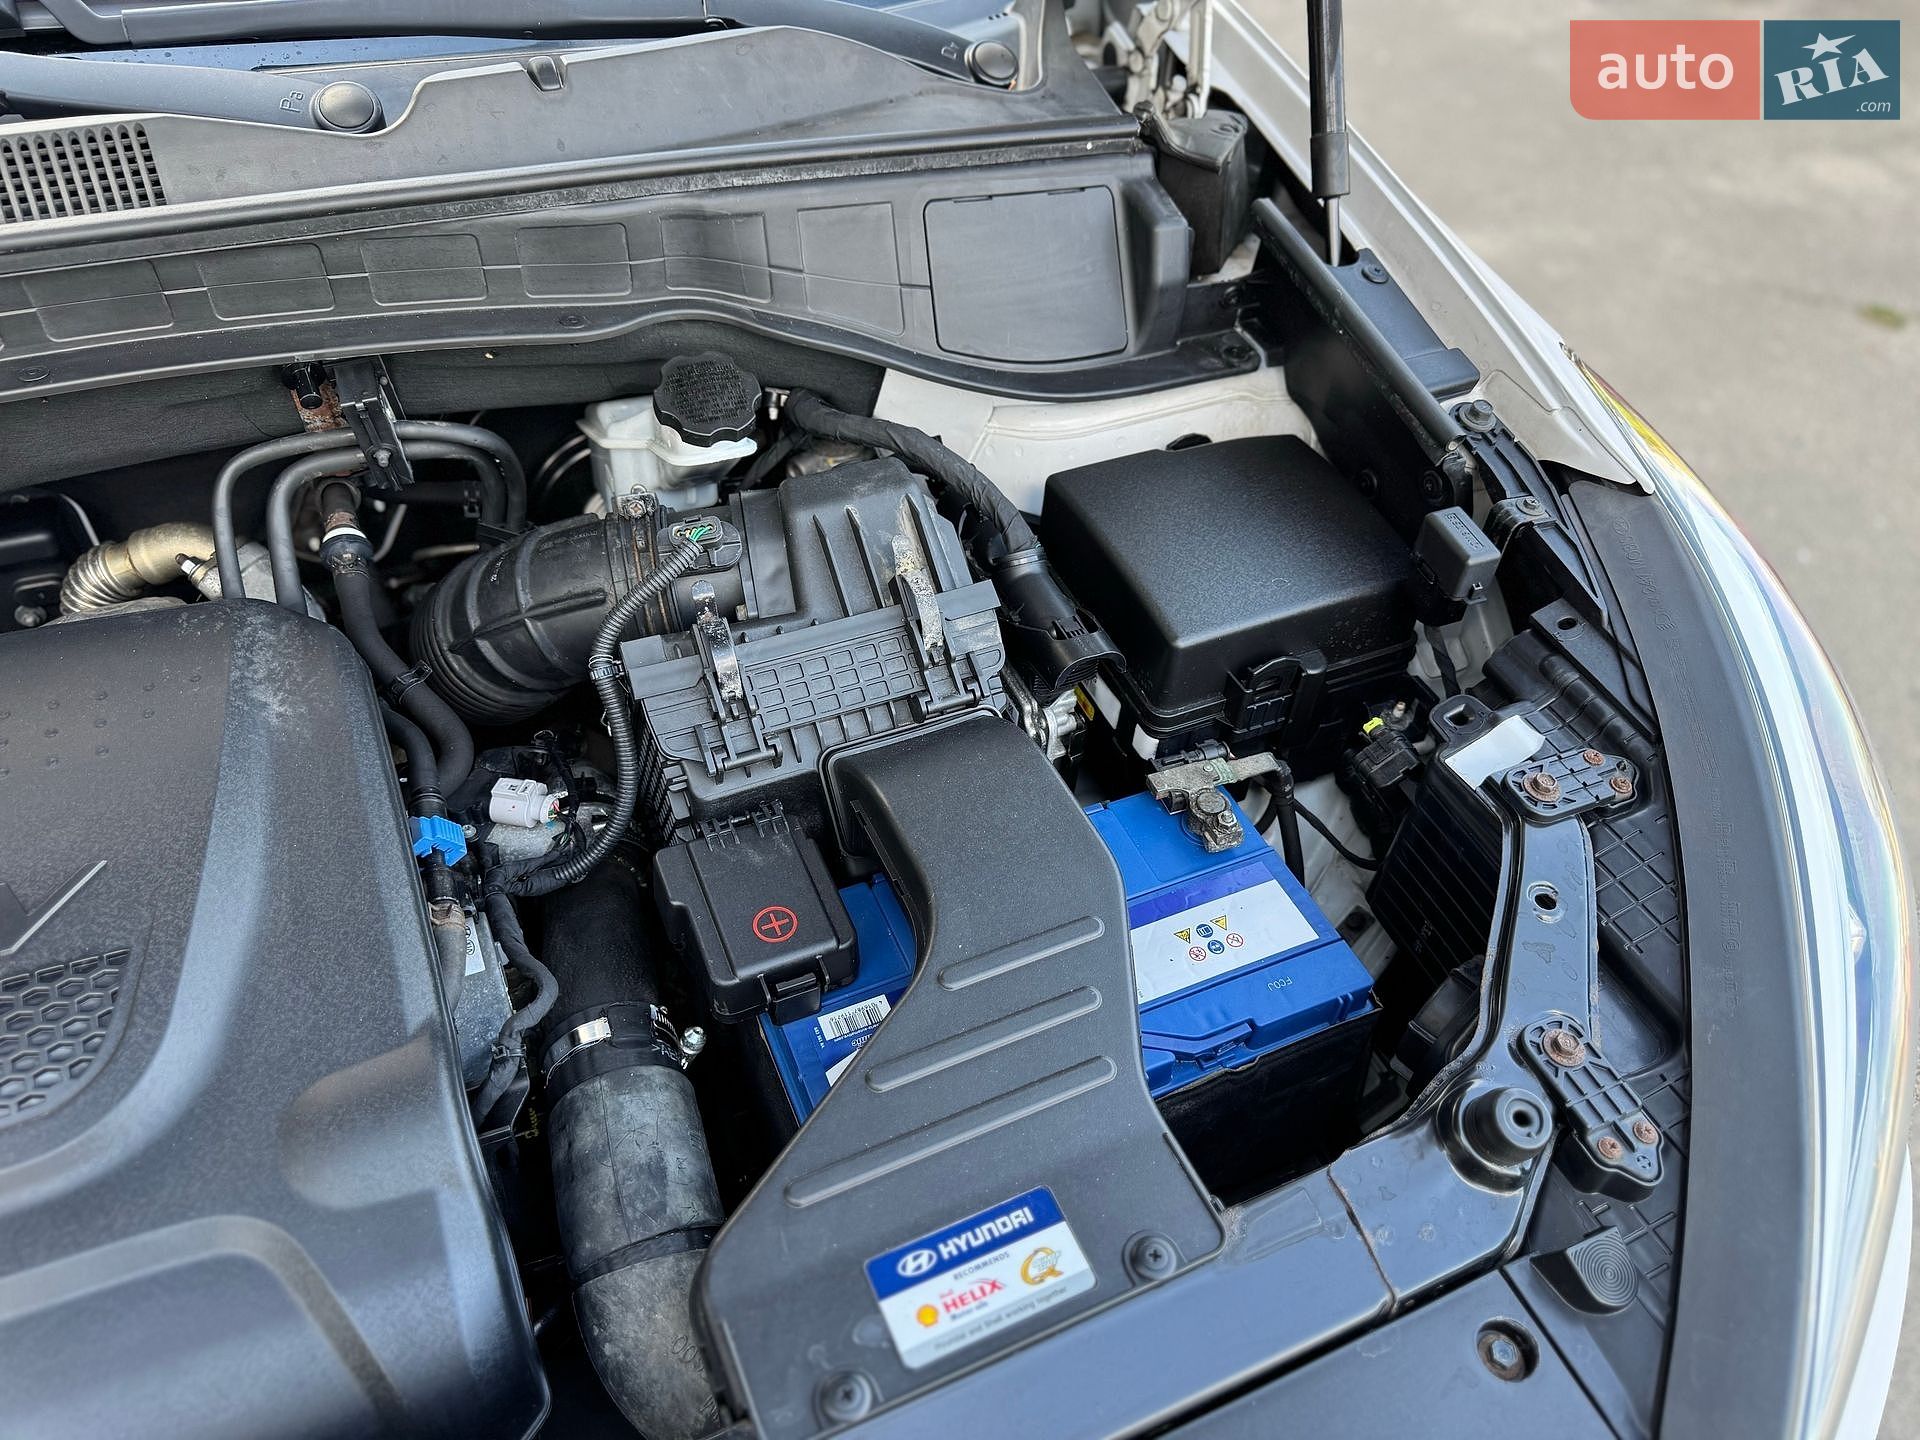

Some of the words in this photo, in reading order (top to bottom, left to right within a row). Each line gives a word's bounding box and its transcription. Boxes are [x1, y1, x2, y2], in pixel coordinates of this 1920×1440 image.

[938, 1207, 1034, 1259] HYUNDAI
[953, 1252, 1010, 1280] RECOMMENDS
[943, 1280, 1003, 1313] HELIX
